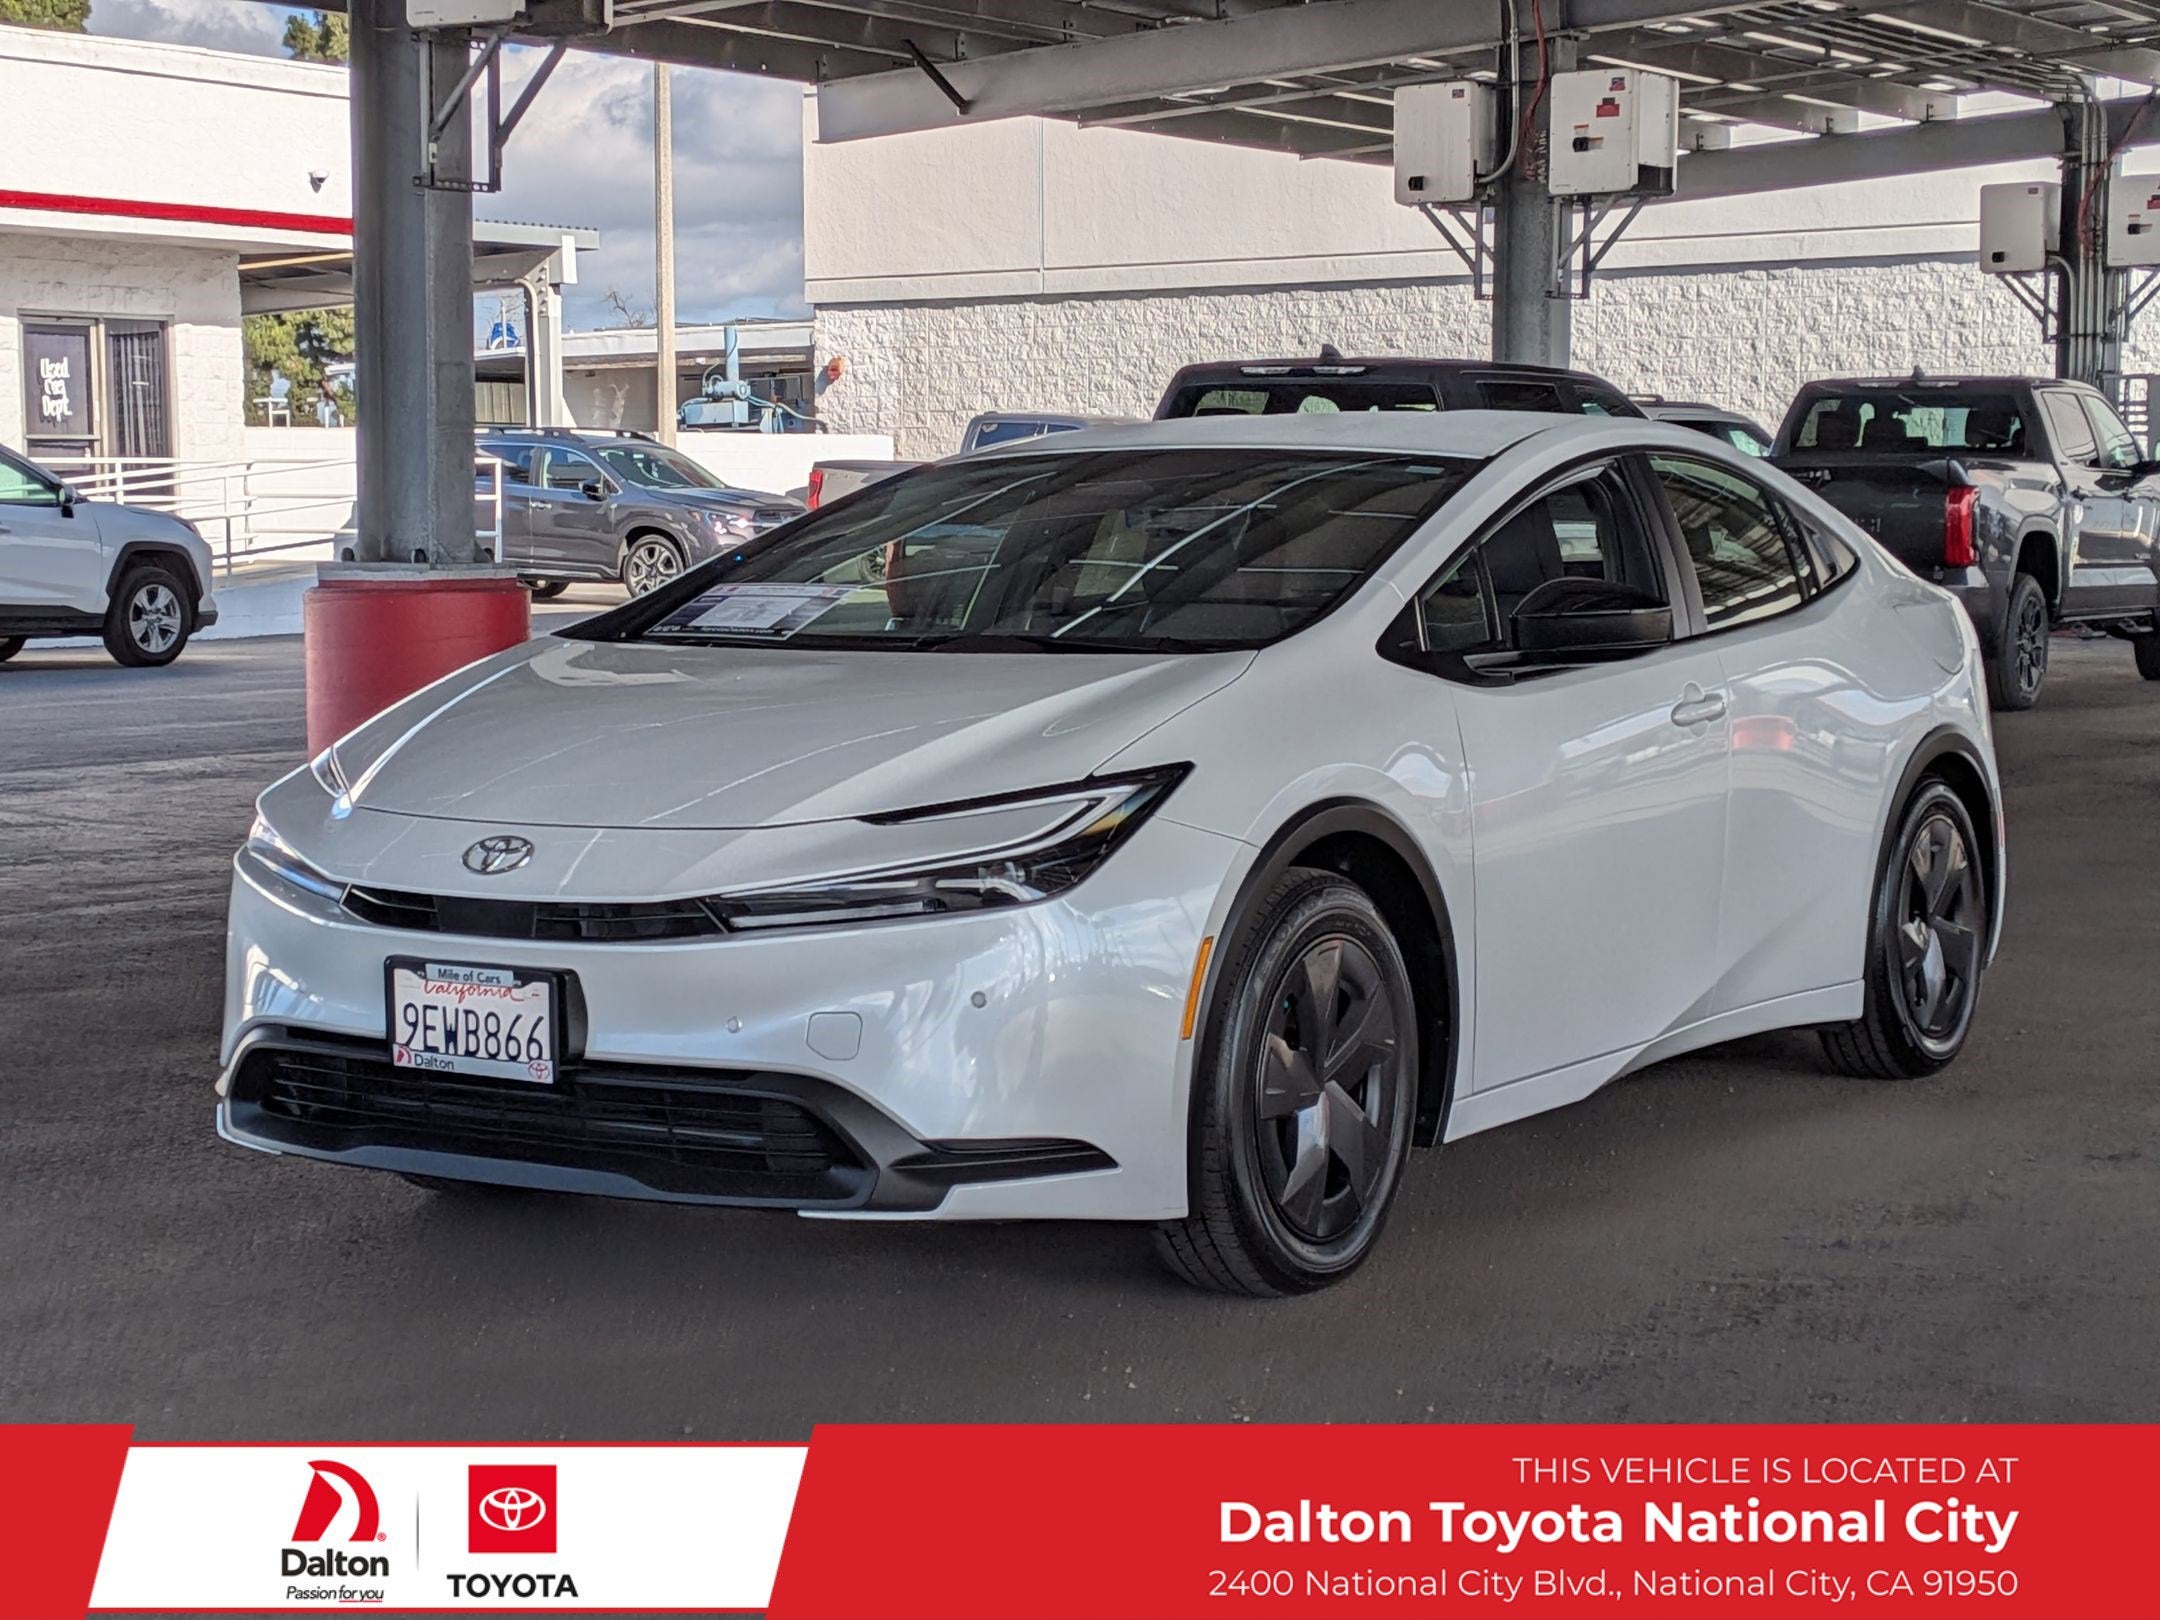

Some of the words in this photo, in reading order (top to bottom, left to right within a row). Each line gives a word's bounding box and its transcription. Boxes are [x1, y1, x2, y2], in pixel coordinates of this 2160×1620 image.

[40, 357, 70, 378] Used
[41, 394, 73, 422] Dept.
[437, 968, 461, 981] Mile
[462, 970, 475, 982] of
[476, 972, 502, 985] Cars
[423, 980, 525, 1004] California
[403, 1001, 544, 1062] 9EWB866
[414, 1053, 455, 1071] Dalton
